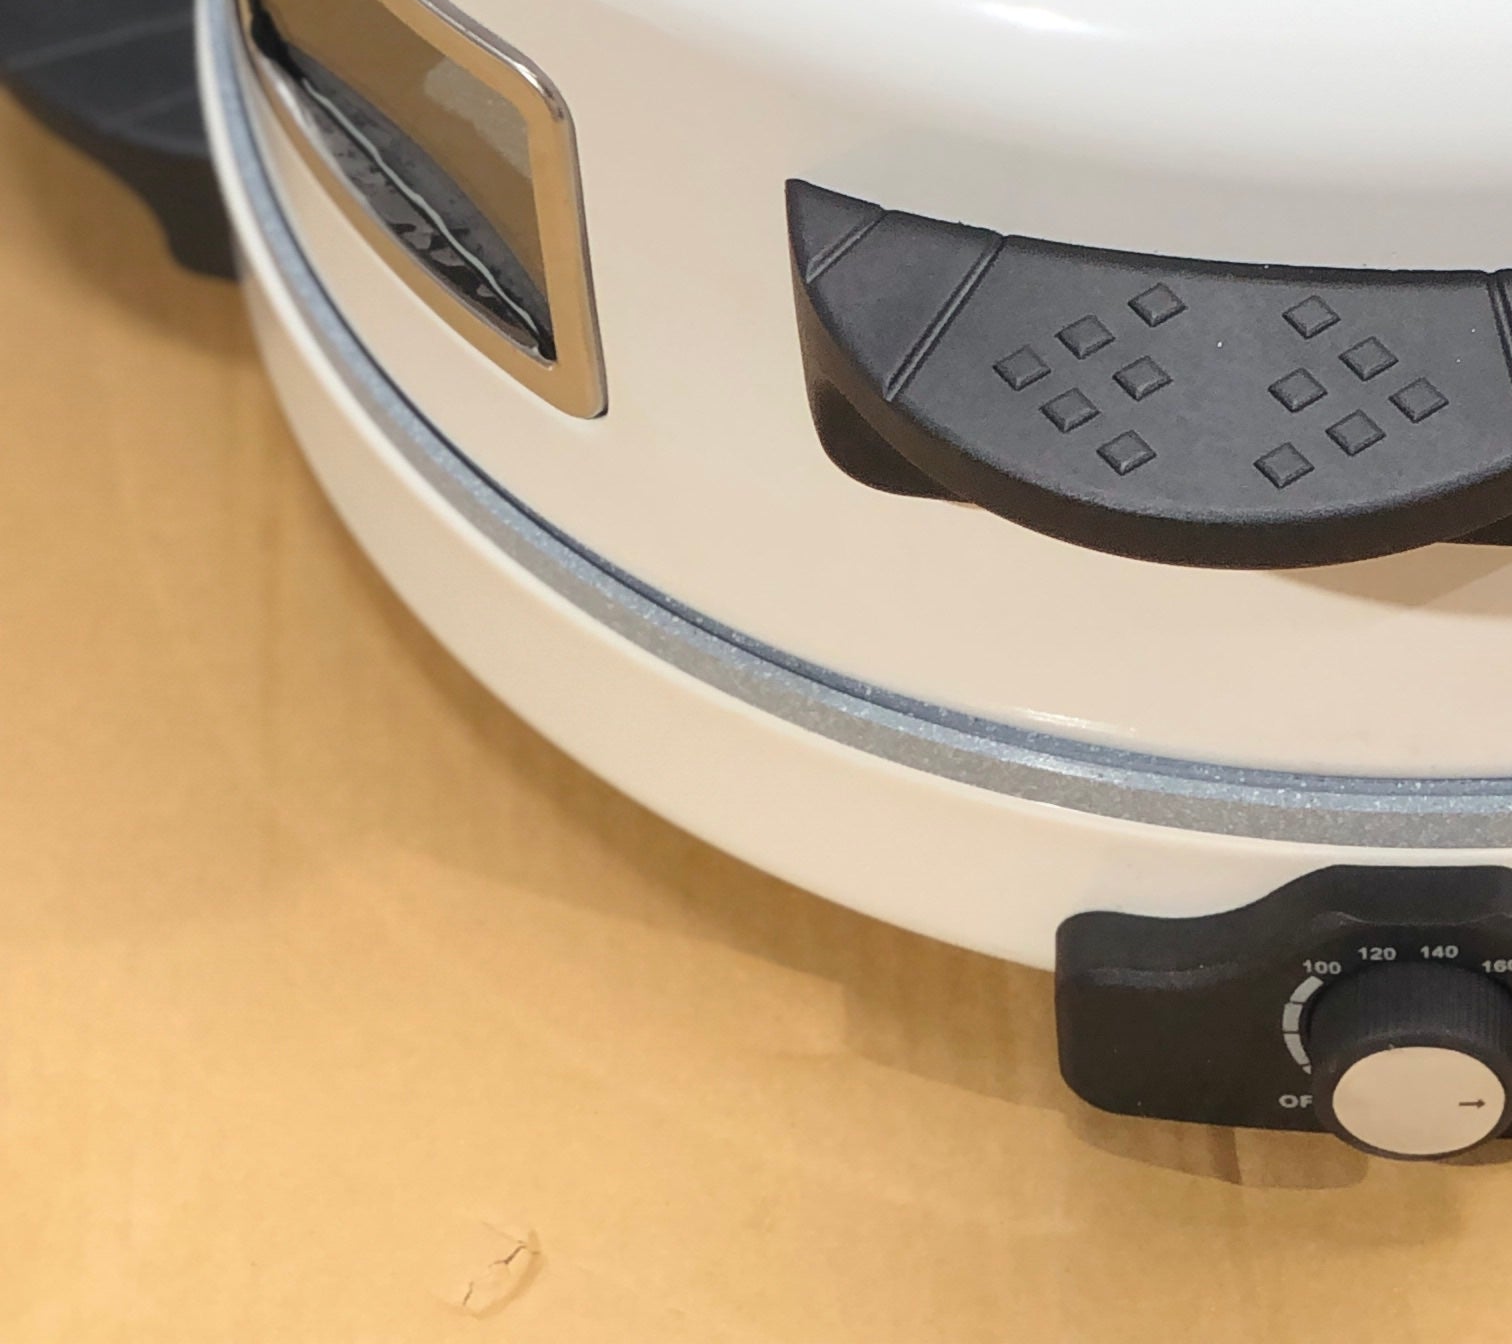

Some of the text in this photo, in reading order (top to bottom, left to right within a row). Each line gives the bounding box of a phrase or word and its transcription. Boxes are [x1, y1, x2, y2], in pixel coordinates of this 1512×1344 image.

[1358, 946, 1397, 961] 120
[1420, 944, 1459, 959] 140
[1302, 959, 1341, 975] 100
[1278, 1094, 1313, 1109] OF
